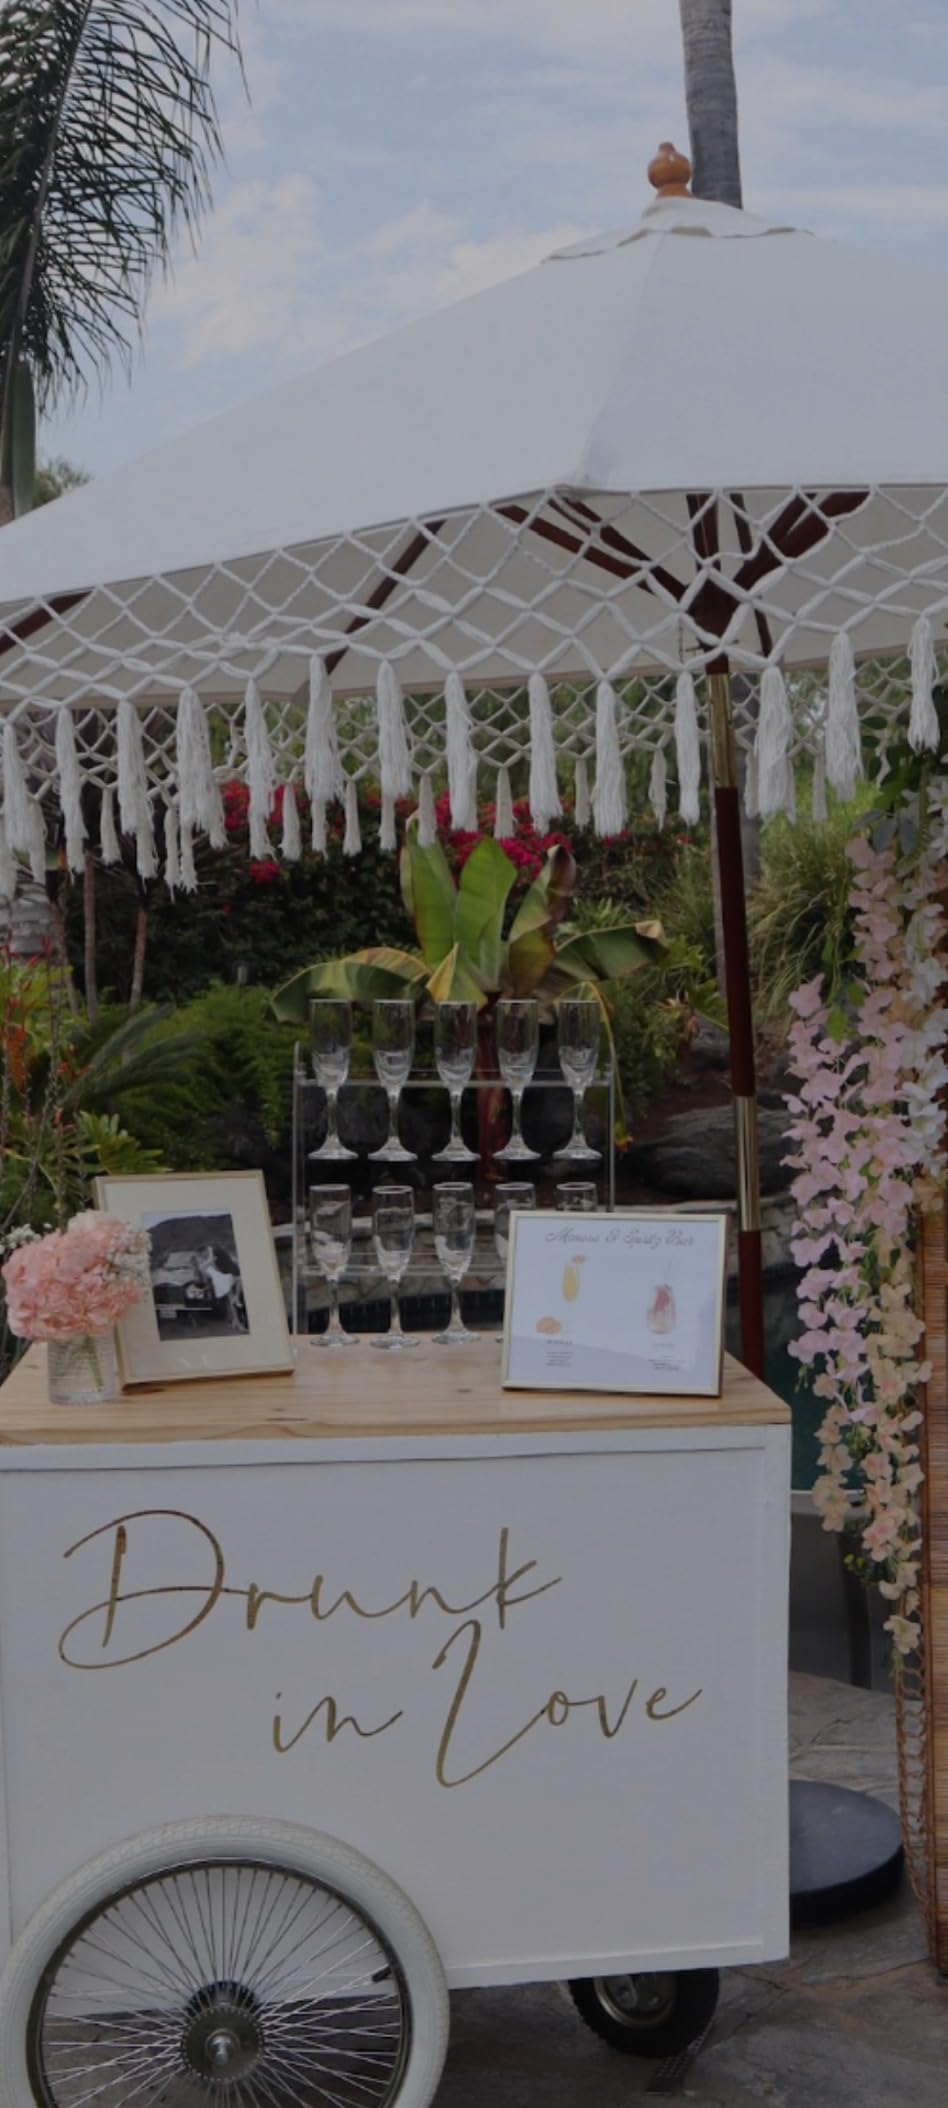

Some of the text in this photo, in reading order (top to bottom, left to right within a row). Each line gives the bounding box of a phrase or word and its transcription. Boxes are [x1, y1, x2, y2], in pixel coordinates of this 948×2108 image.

[59, 1509, 562, 1669] Drunk
[273, 1619, 702, 1788] in Love
